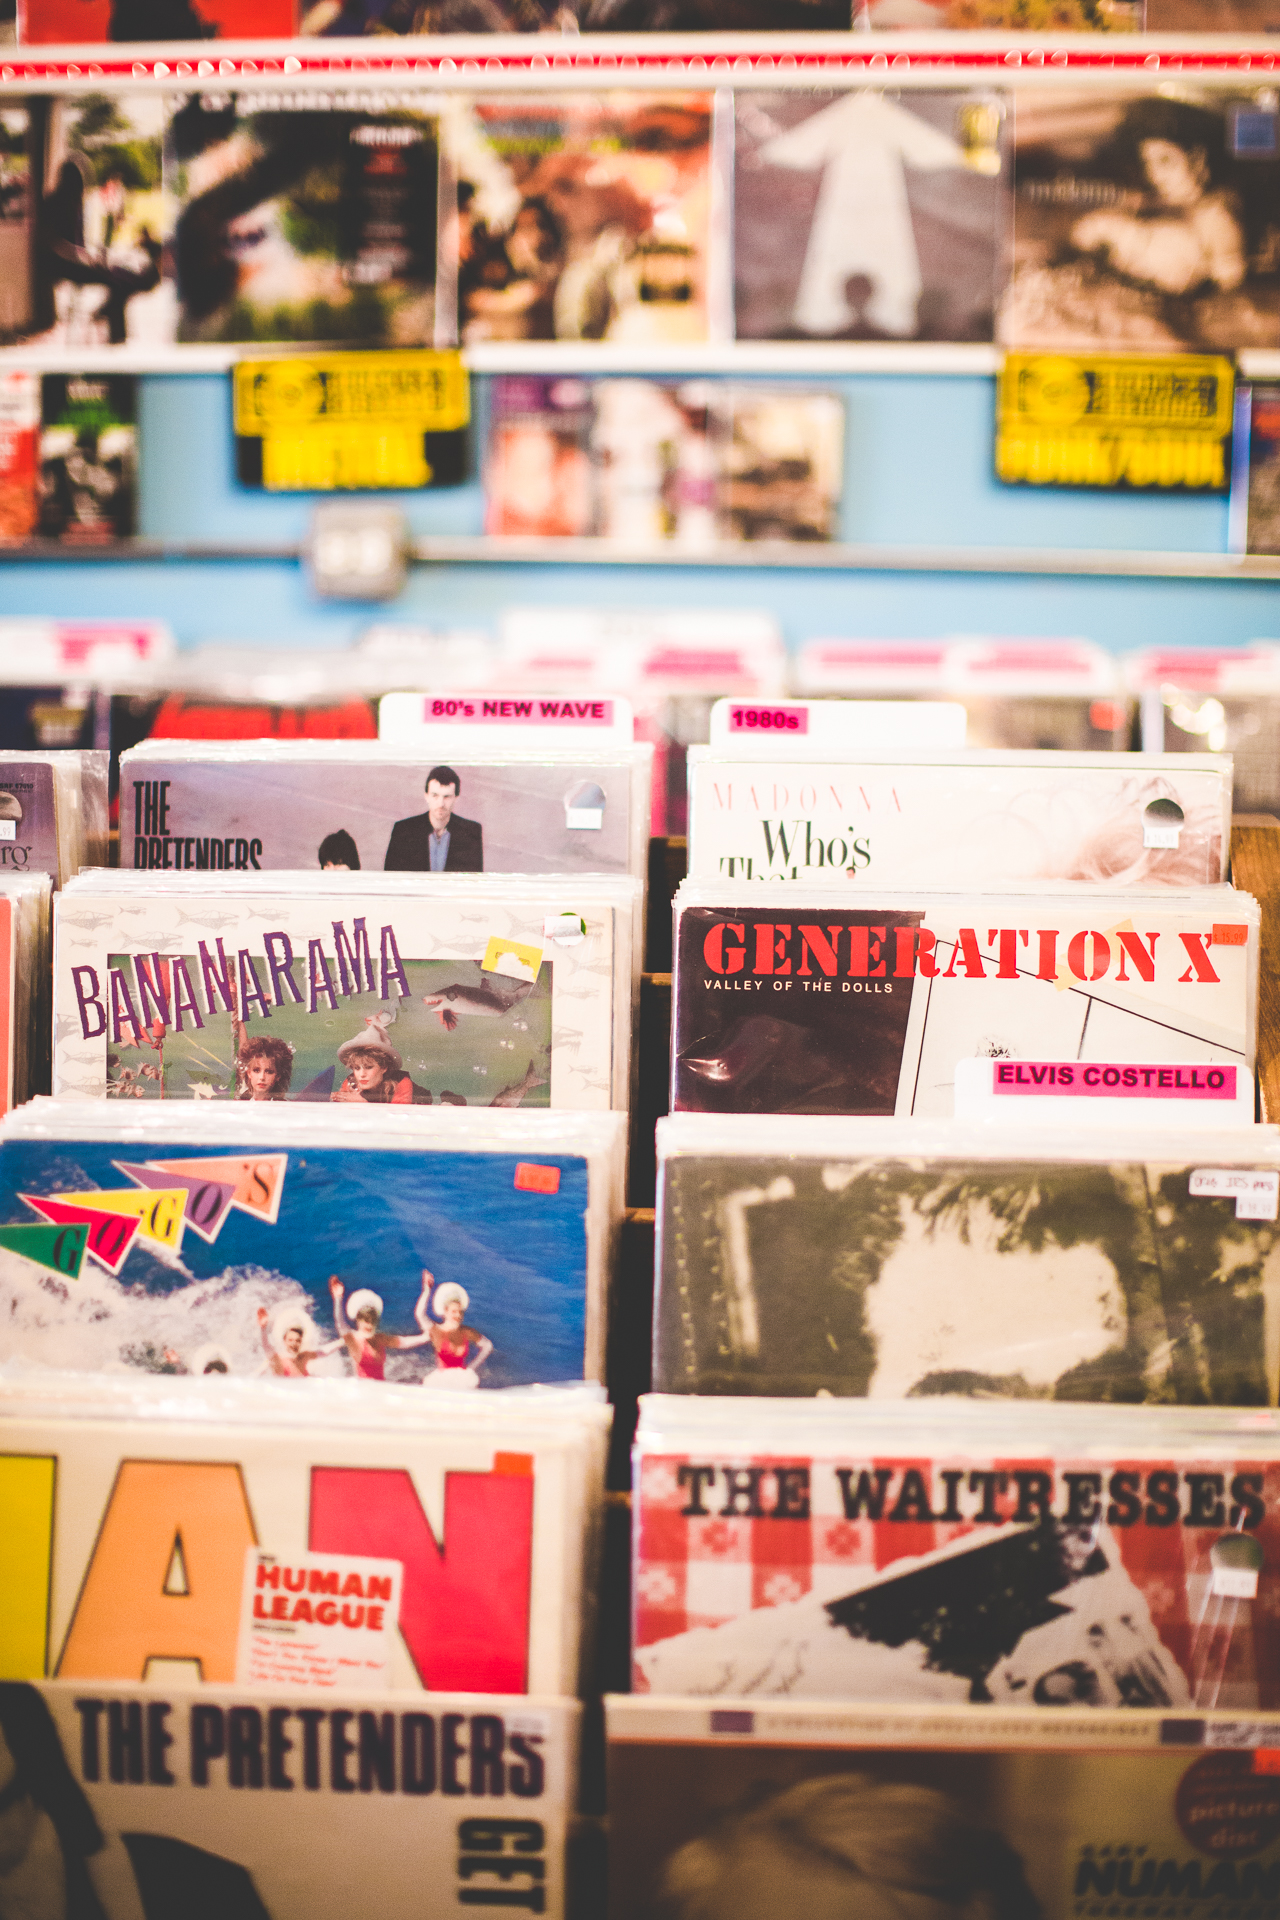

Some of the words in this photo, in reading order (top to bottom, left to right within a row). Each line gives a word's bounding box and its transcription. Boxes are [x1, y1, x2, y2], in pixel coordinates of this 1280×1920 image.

[432, 701, 475, 717] 80's
[483, 702, 533, 718] NEW
[540, 703, 605, 719] WAVE
[733, 710, 800, 729] 1980s
[133, 781, 171, 835] THE
[713, 783, 902, 813] MADONNA
[759, 819, 871, 869] Who's
[703, 922, 1161, 982] GENERATION
[1178, 932, 1221, 983] X
[71, 917, 412, 1043] BANANARAMA
[703, 980, 763, 991] VALLEY
[773, 981, 793, 991] OF
[803, 981, 832, 992] THE
[842, 982, 893, 993] DOLLS
[998, 1064, 1074, 1086] ELVIS
[1083, 1066, 1225, 1089] COSTELLO
[677, 1464, 811, 1519] THE
[835, 1467, 1266, 1528] WAITRESSES
[255, 1563, 393, 1602] HUMAN
[252, 1594, 386, 1632] LEAGUE
[75, 1698, 177, 1787] THE
[1073, 1859, 1280, 1899] NUMAN
